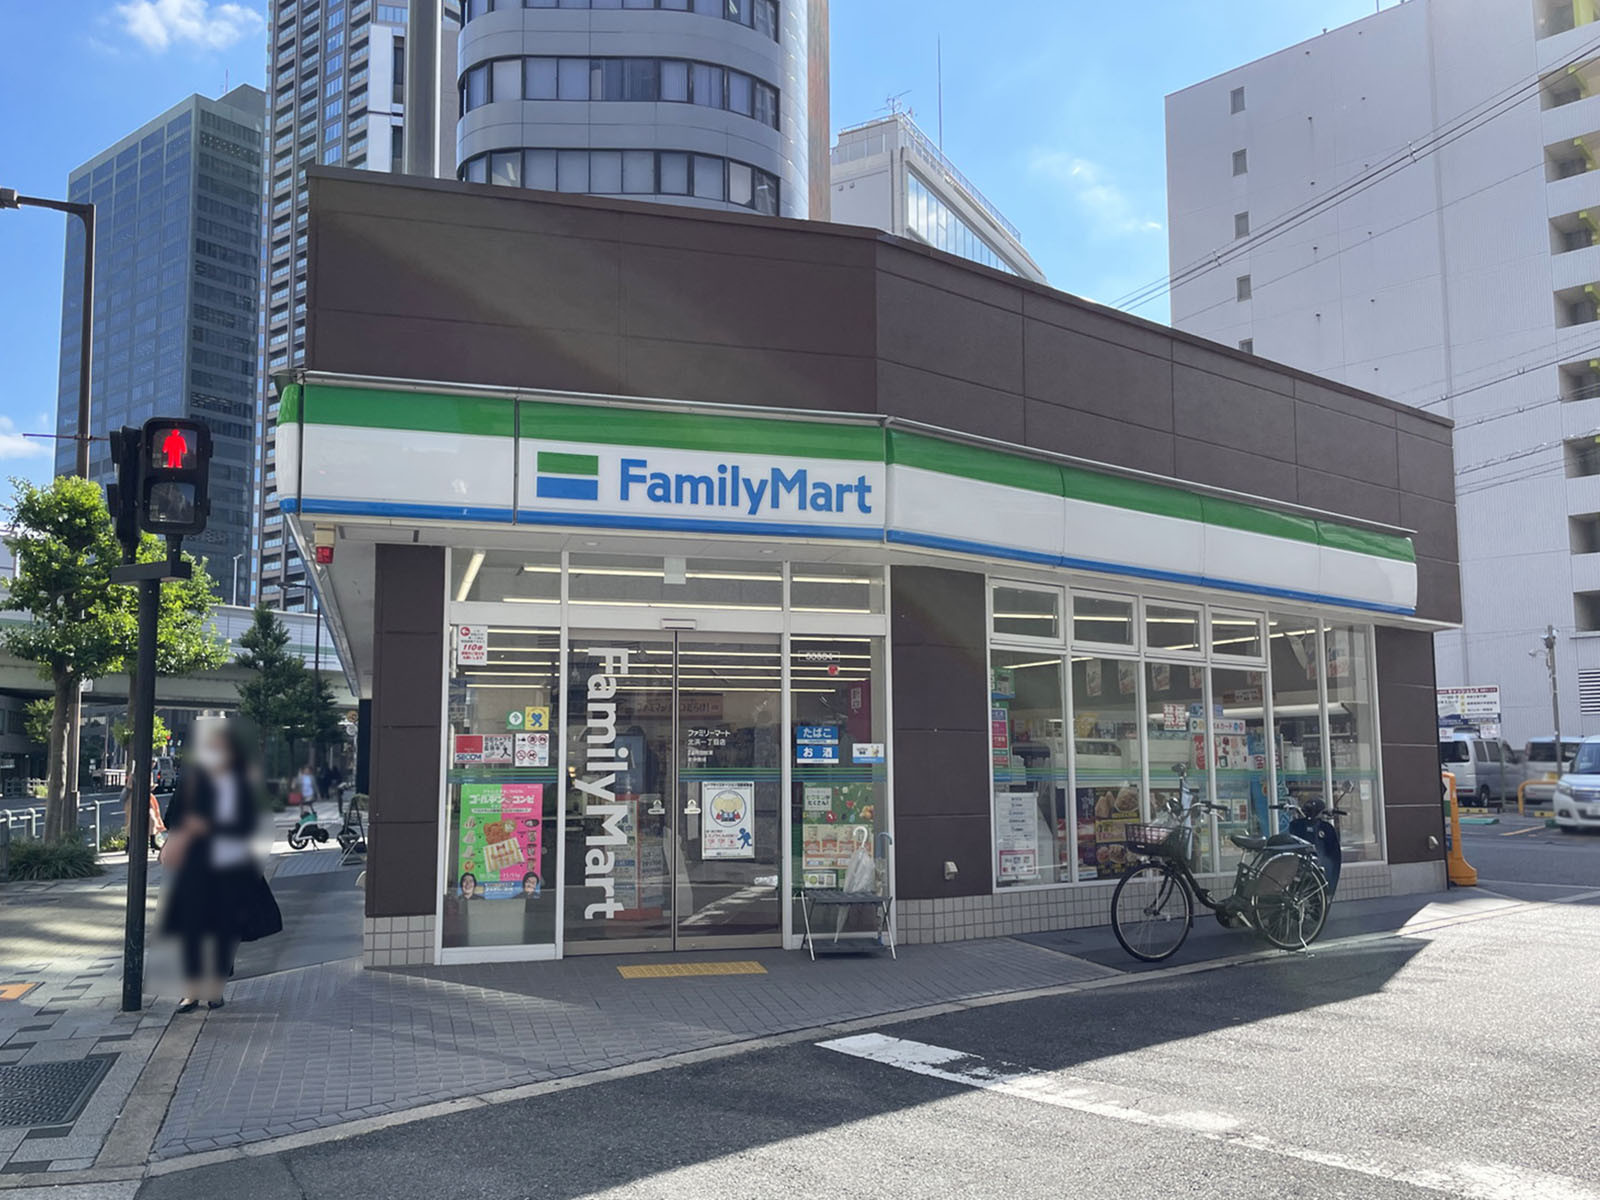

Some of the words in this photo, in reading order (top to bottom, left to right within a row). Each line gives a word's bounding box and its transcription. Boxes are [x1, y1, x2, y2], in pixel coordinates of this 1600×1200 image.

[620, 458, 872, 515] FamilyMart
[688, 729, 731, 737] ファミリーマート
[803, 727, 832, 738] たばこ
[456, 753, 482, 761] SECOM
[575, 648, 629, 920] FamilyMart
